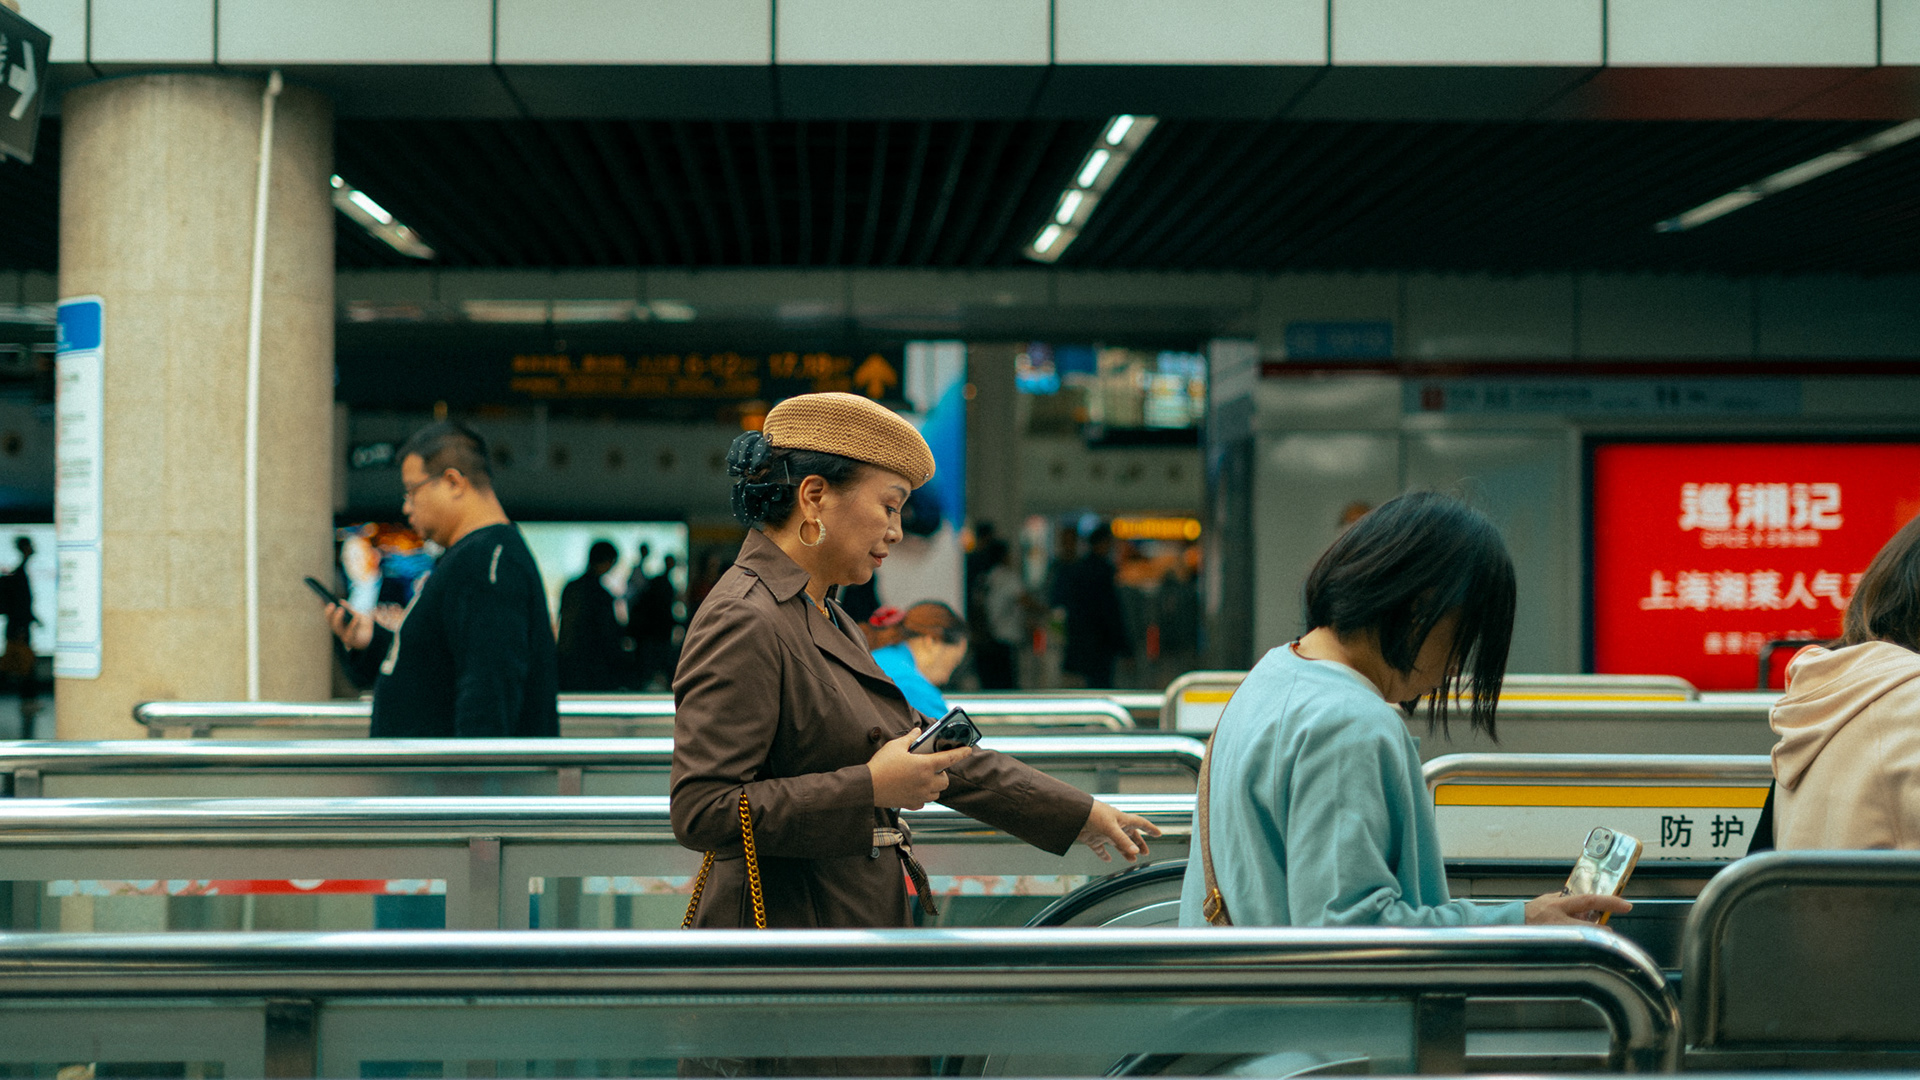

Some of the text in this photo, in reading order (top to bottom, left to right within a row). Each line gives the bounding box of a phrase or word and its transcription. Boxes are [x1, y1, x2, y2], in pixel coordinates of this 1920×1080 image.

[1638, 569, 1864, 611] 上海湘菜人气
[1661, 815, 1744, 848] 防护
